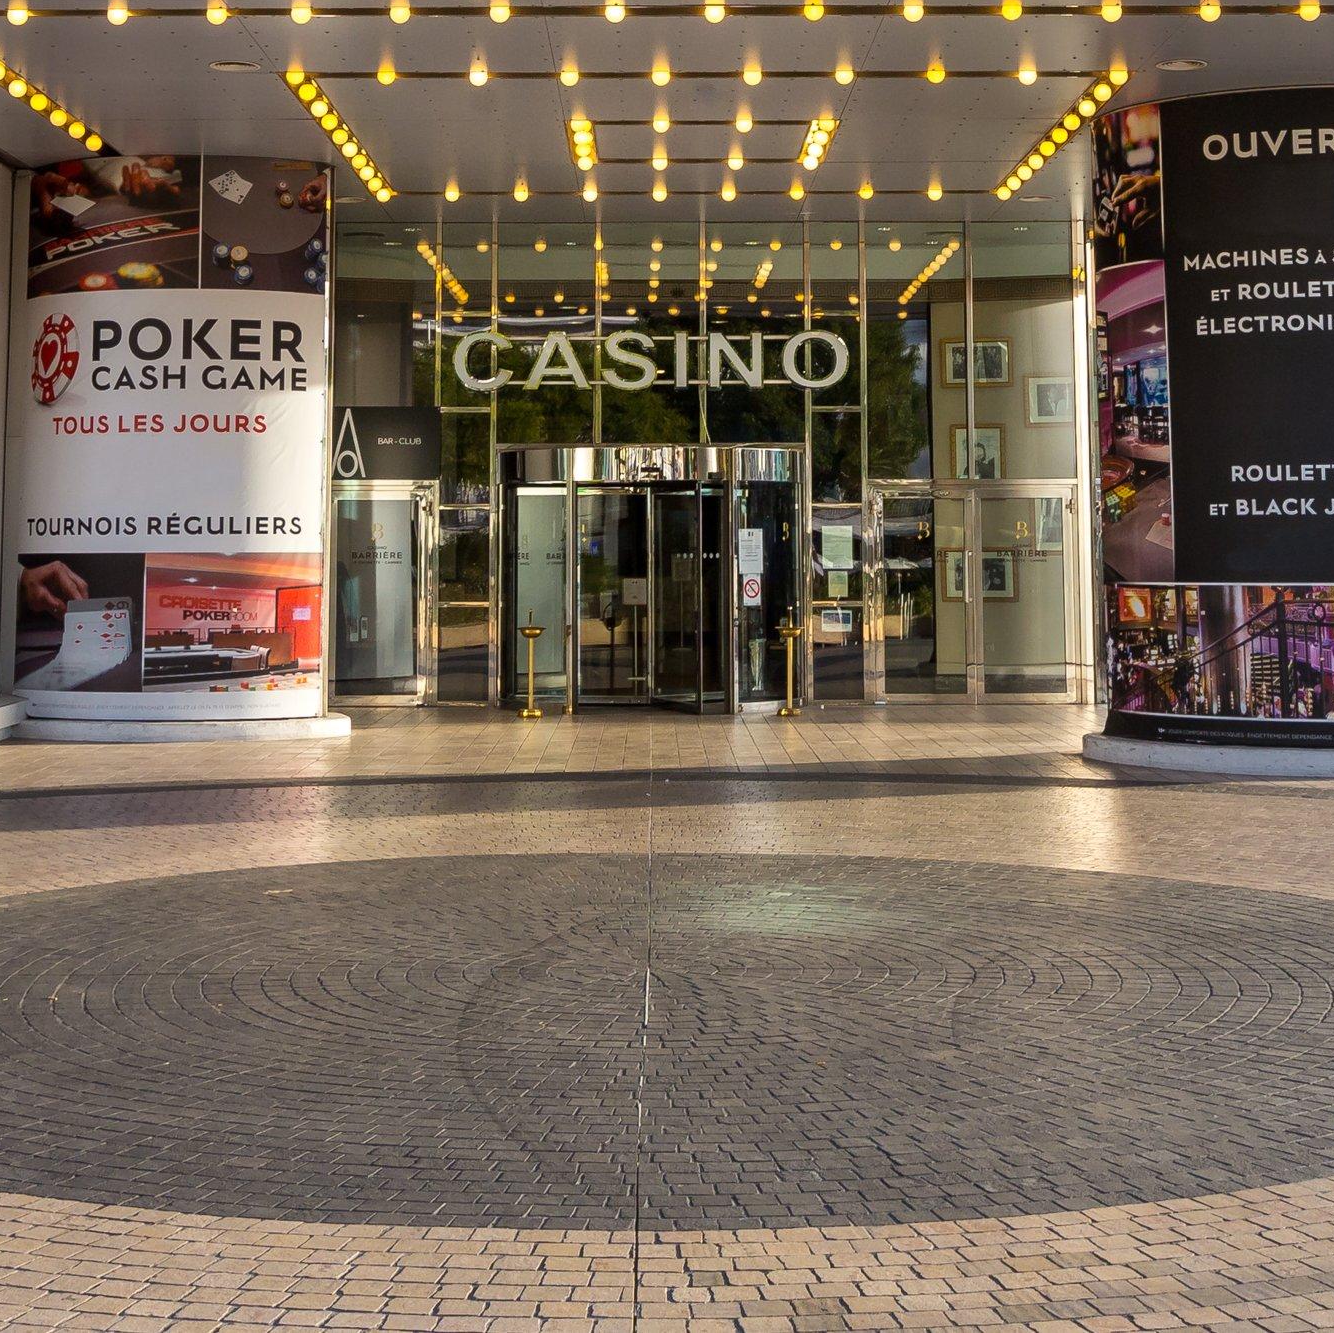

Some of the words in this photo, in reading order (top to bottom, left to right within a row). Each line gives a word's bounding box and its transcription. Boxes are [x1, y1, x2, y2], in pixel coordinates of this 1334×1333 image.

[45, 222, 180, 260] POKER
[1183, 247, 1309, 271] MACHINES
[1314, 249, 1327, 264] À
[1210, 289, 1231, 302] ET
[92, 318, 305, 362] POKER
[452, 329, 850, 392] CASINO
[91, 365, 186, 391] CASH
[202, 366, 307, 391] GAME
[53, 416, 109, 435] TOUS
[118, 414, 164, 433] LES
[173, 414, 267, 434] JOURS
[1209, 503, 1229, 516] ET
[1236, 498, 1317, 516] BLACK
[27, 516, 137, 536] TOURNOIS
[147, 513, 302, 535] RÉGULIERS
[158, 595, 242, 609] CROISETTE
